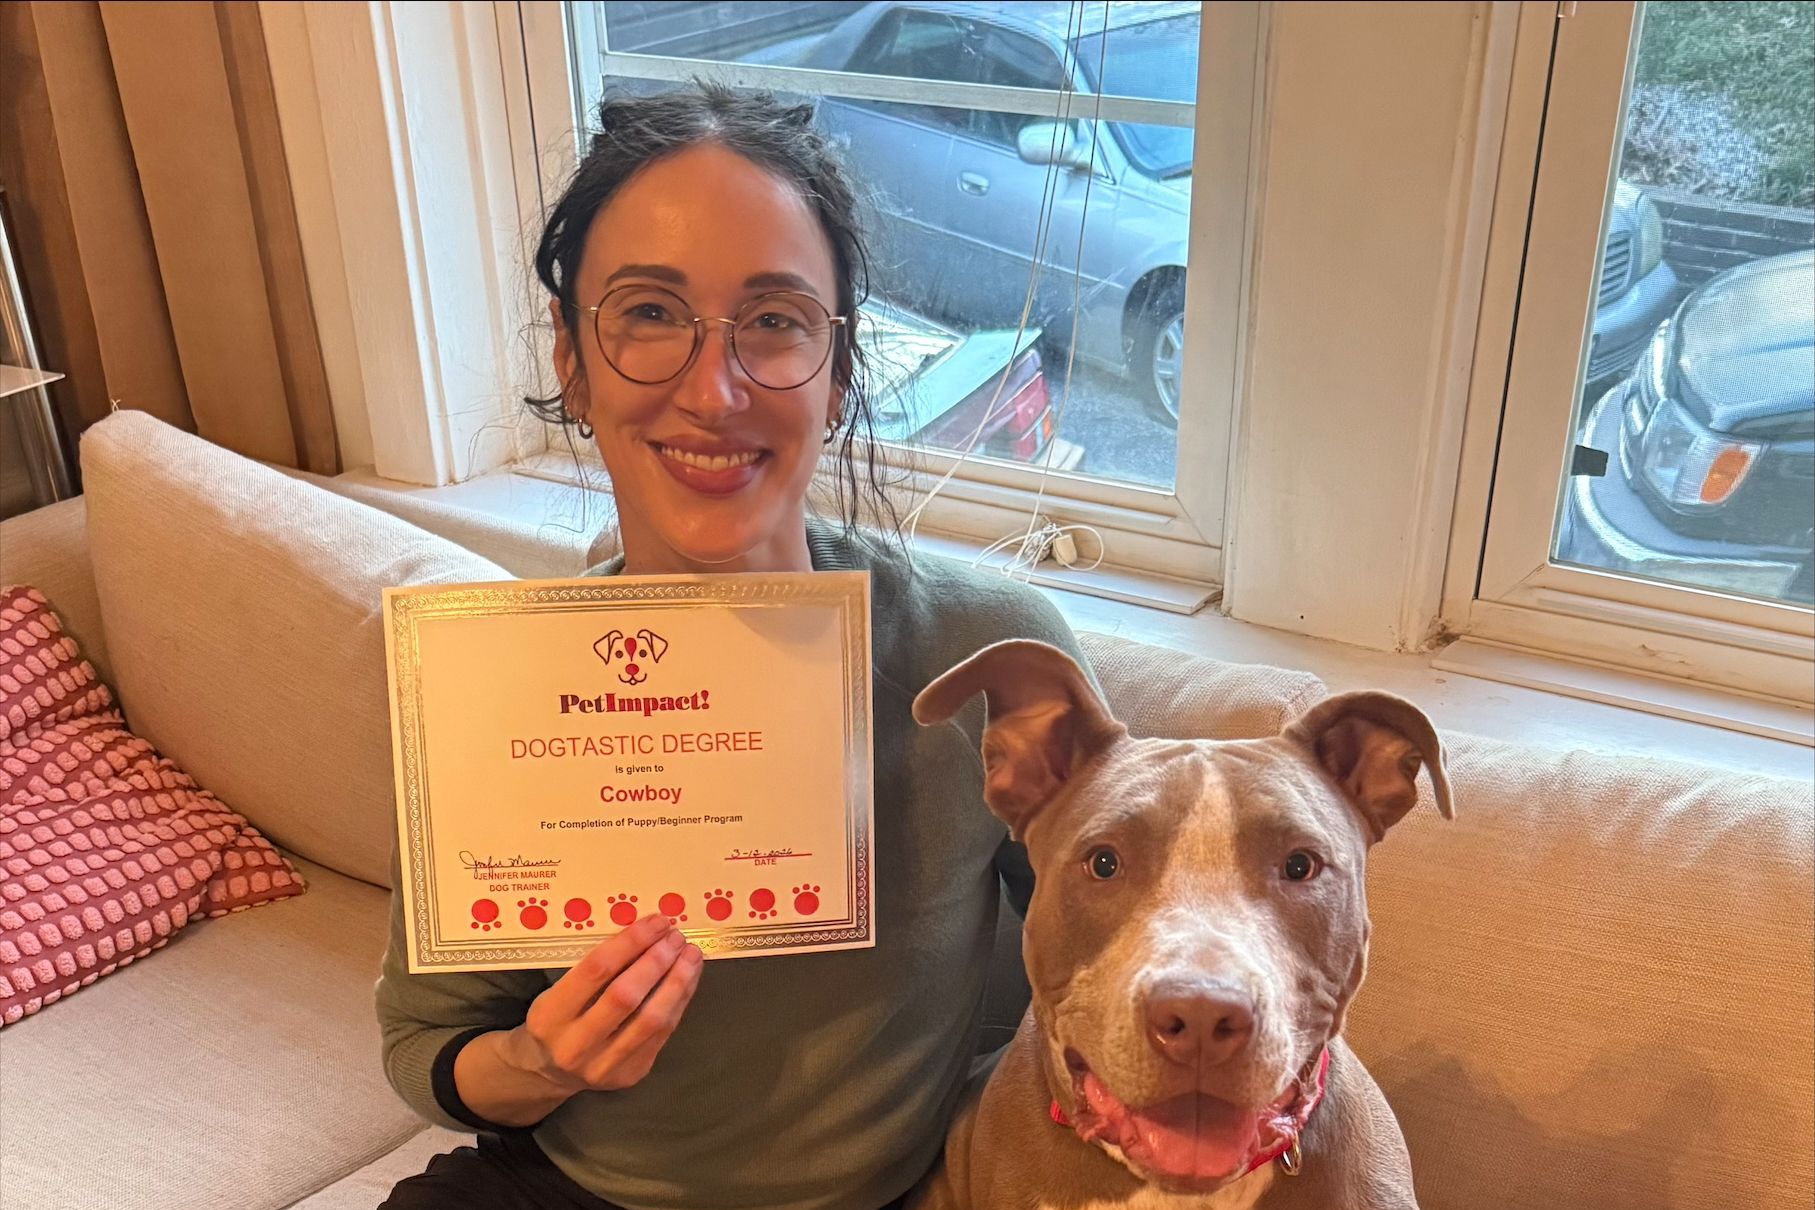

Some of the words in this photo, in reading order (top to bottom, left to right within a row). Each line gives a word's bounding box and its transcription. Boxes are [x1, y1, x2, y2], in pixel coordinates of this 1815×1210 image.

[559, 690, 710, 716] PetImpact!
[511, 735, 654, 759] DOGTASTIC
[663, 731, 763, 754] DEGREE
[615, 765, 624, 774] is
[626, 765, 652, 776] given
[654, 764, 664, 773] to
[600, 785, 682, 804] Cowboy
[541, 820, 556, 829] For
[559, 818, 613, 829] Completion
[615, 818, 625, 827] of
[627, 815, 702, 828] Puppy/Beginner
[704, 814, 743, 825] Program
[755, 858, 777, 866] DATE
[478, 871, 518, 880] JENNIFER
[520, 870, 557, 879] MAURER
[490, 884, 509, 892] DOG
[512, 883, 550, 891] TRAINER
